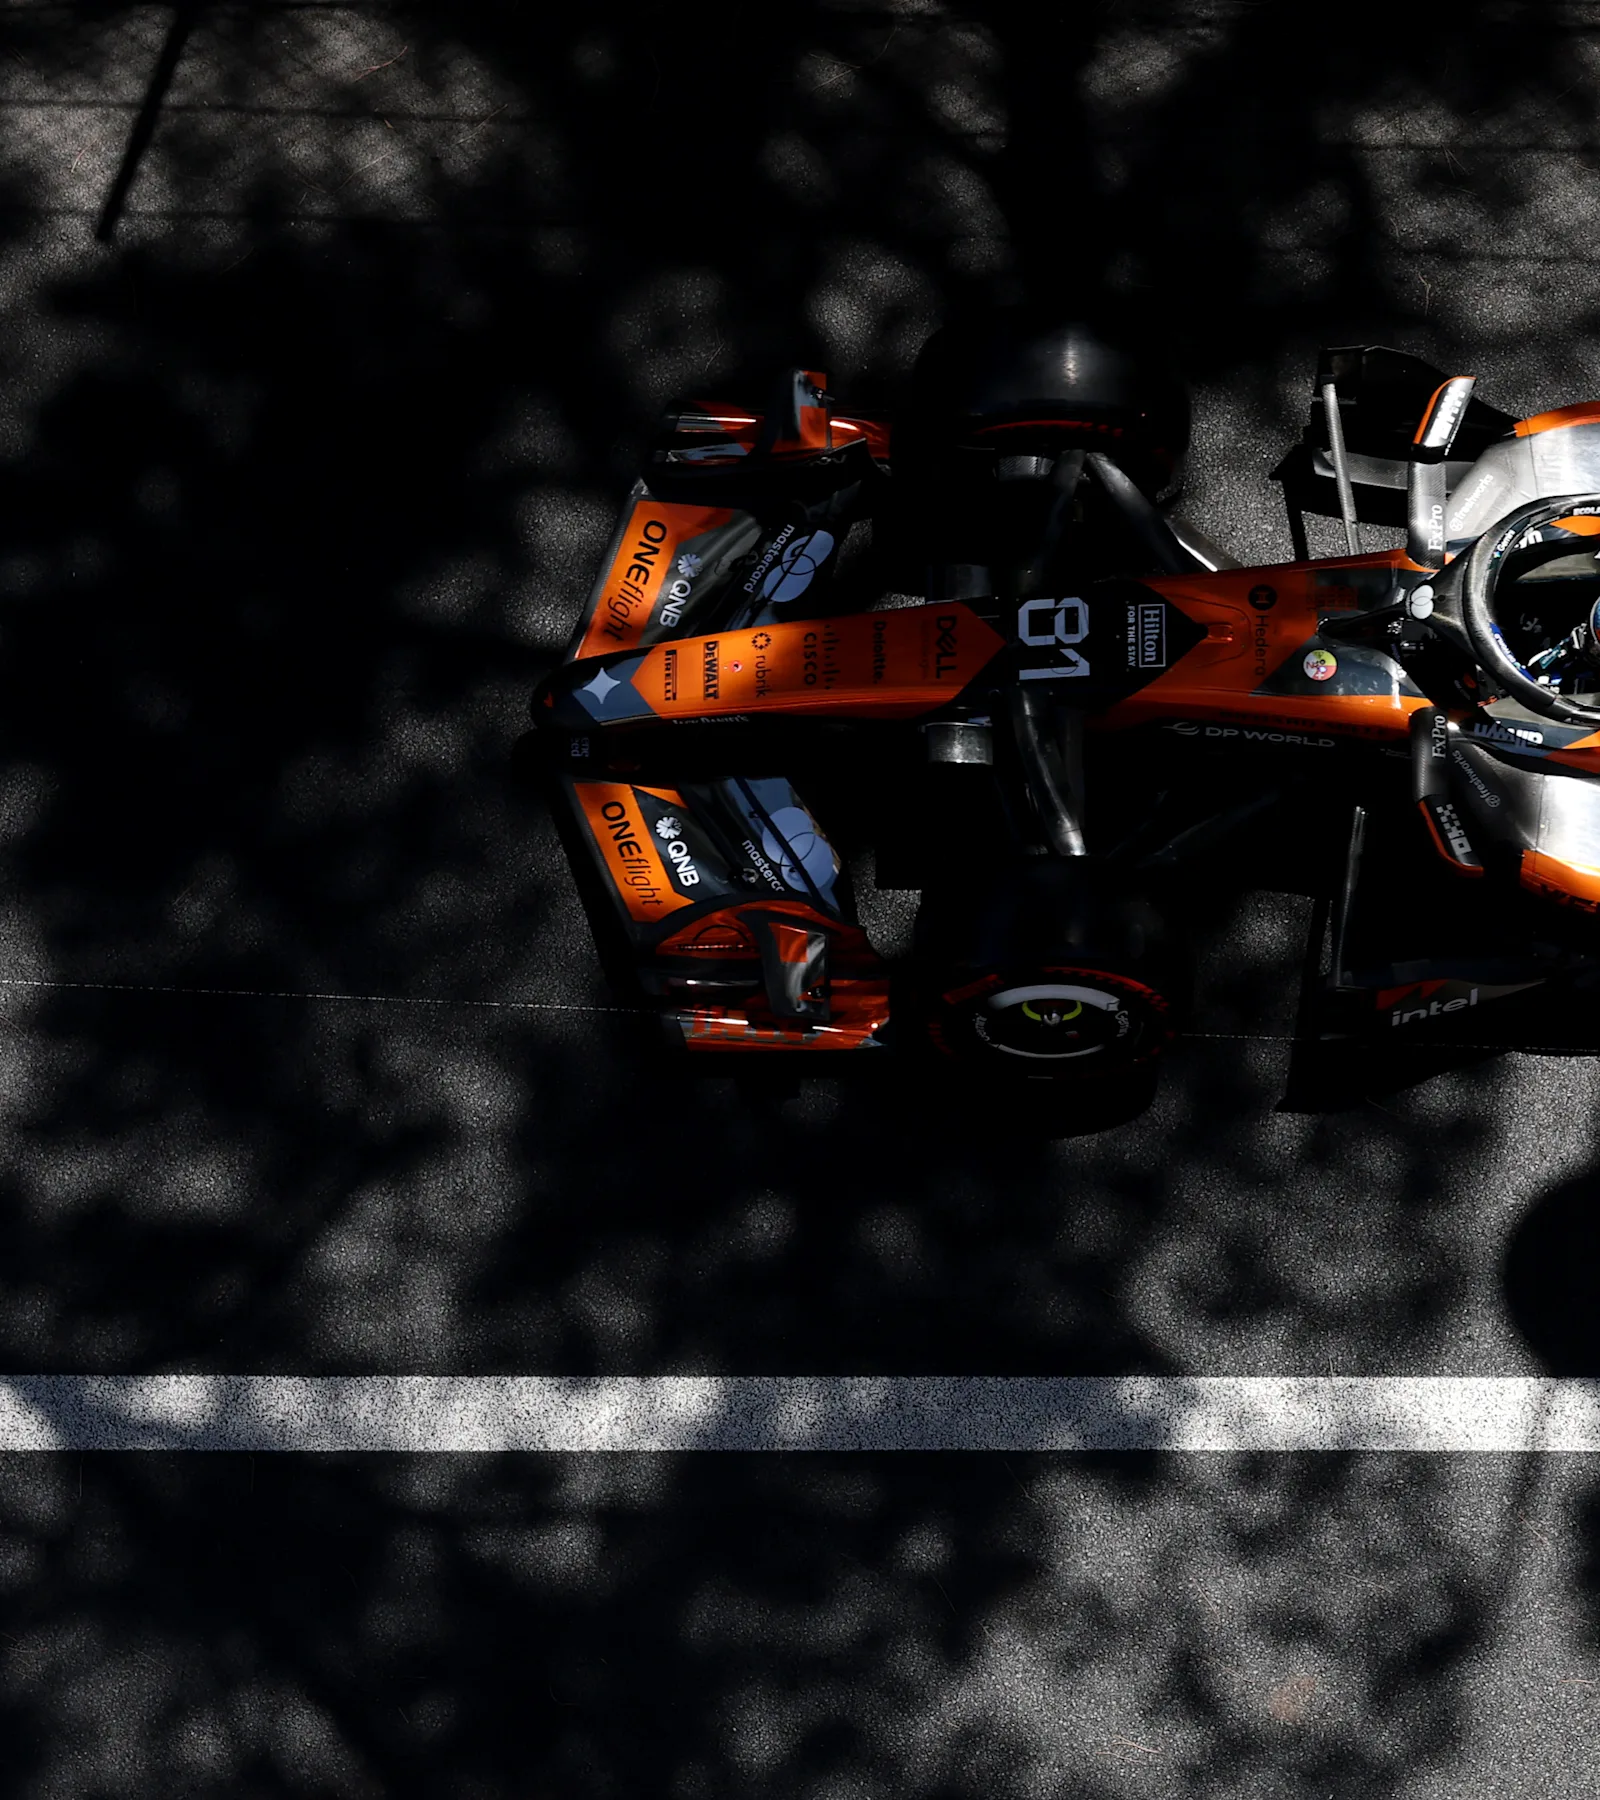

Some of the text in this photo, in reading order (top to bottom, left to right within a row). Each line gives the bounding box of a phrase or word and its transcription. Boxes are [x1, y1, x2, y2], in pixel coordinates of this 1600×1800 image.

[1457, 474, 1493, 520] freshworks
[1428, 504, 1443, 551] FxPro
[604, 520, 667, 641] ONEflight
[743, 523, 796, 593] mastercard
[659, 579, 692, 628] QNB
[803, 632, 818, 686] CISCO
[872, 621, 888, 685] Deloitte.
[935, 616, 958, 680] DELL
[1017, 597, 1091, 681] 81
[1126, 605, 1137, 667] FOR THE STAY
[1143, 608, 1160, 663] Hilton
[1255, 615, 1271, 676] Hedera
[665, 650, 677, 700] PIRELLI
[755, 655, 772, 698] rubrik
[1204, 726, 1336, 748] DP WORLD
[1432, 714, 1447, 759] FxPro
[1452, 750, 1491, 799] freshworks
[601, 801, 664, 906] ONEflight
[667, 840, 701, 887] QNB
[1391, 987, 1479, 1027] intel
